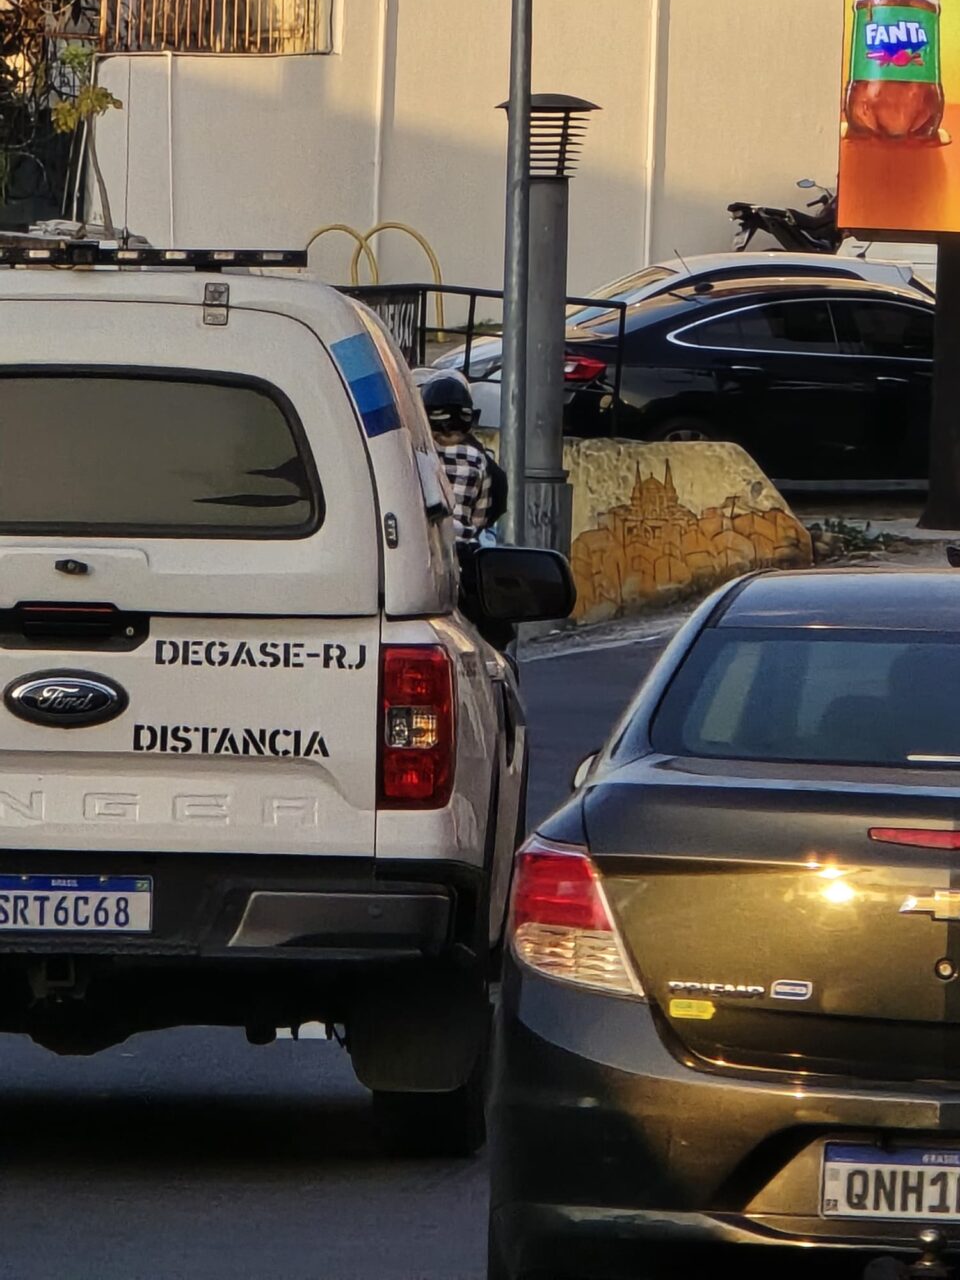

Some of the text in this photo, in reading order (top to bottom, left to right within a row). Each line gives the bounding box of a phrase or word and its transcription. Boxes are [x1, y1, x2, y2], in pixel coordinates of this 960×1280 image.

[865, 22, 927, 46] FANTA
[155, 640, 367, 670] DEGASE-RJ
[37, 686, 93, 710] Ford
[133, 724, 330, 757] DISTANCIA
[0, 894, 130, 927] SRT6C68
